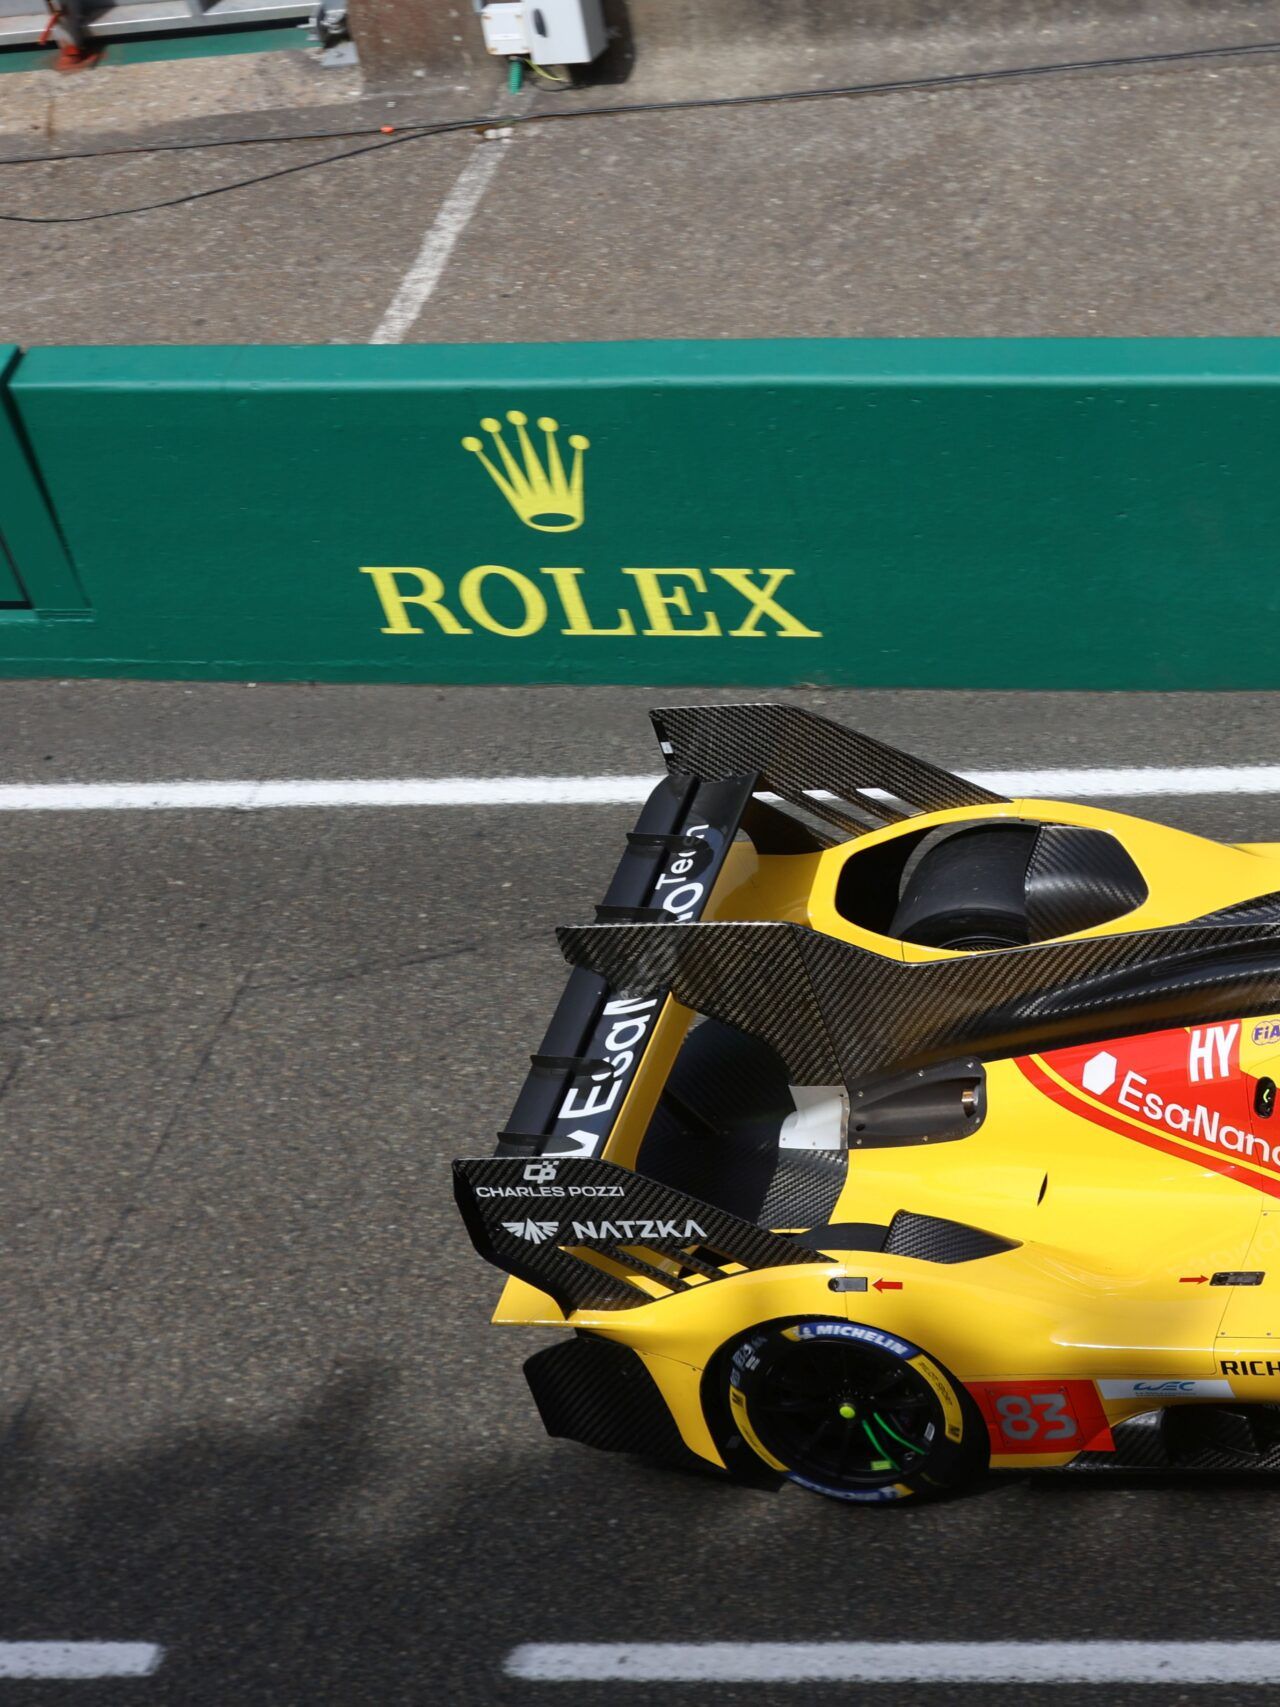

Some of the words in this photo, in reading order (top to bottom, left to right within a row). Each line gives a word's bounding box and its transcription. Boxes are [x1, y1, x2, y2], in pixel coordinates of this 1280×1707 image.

[359, 565, 823, 639] ROLEX
[1189, 1023, 1239, 1082] HY
[475, 1186, 565, 1198] CHARLES
[568, 1185, 625, 1197] POZZI
[571, 1219, 708, 1239] NATZKA
[816, 1324, 910, 1356] MICHELIN
[995, 1393, 1077, 1441] 83
